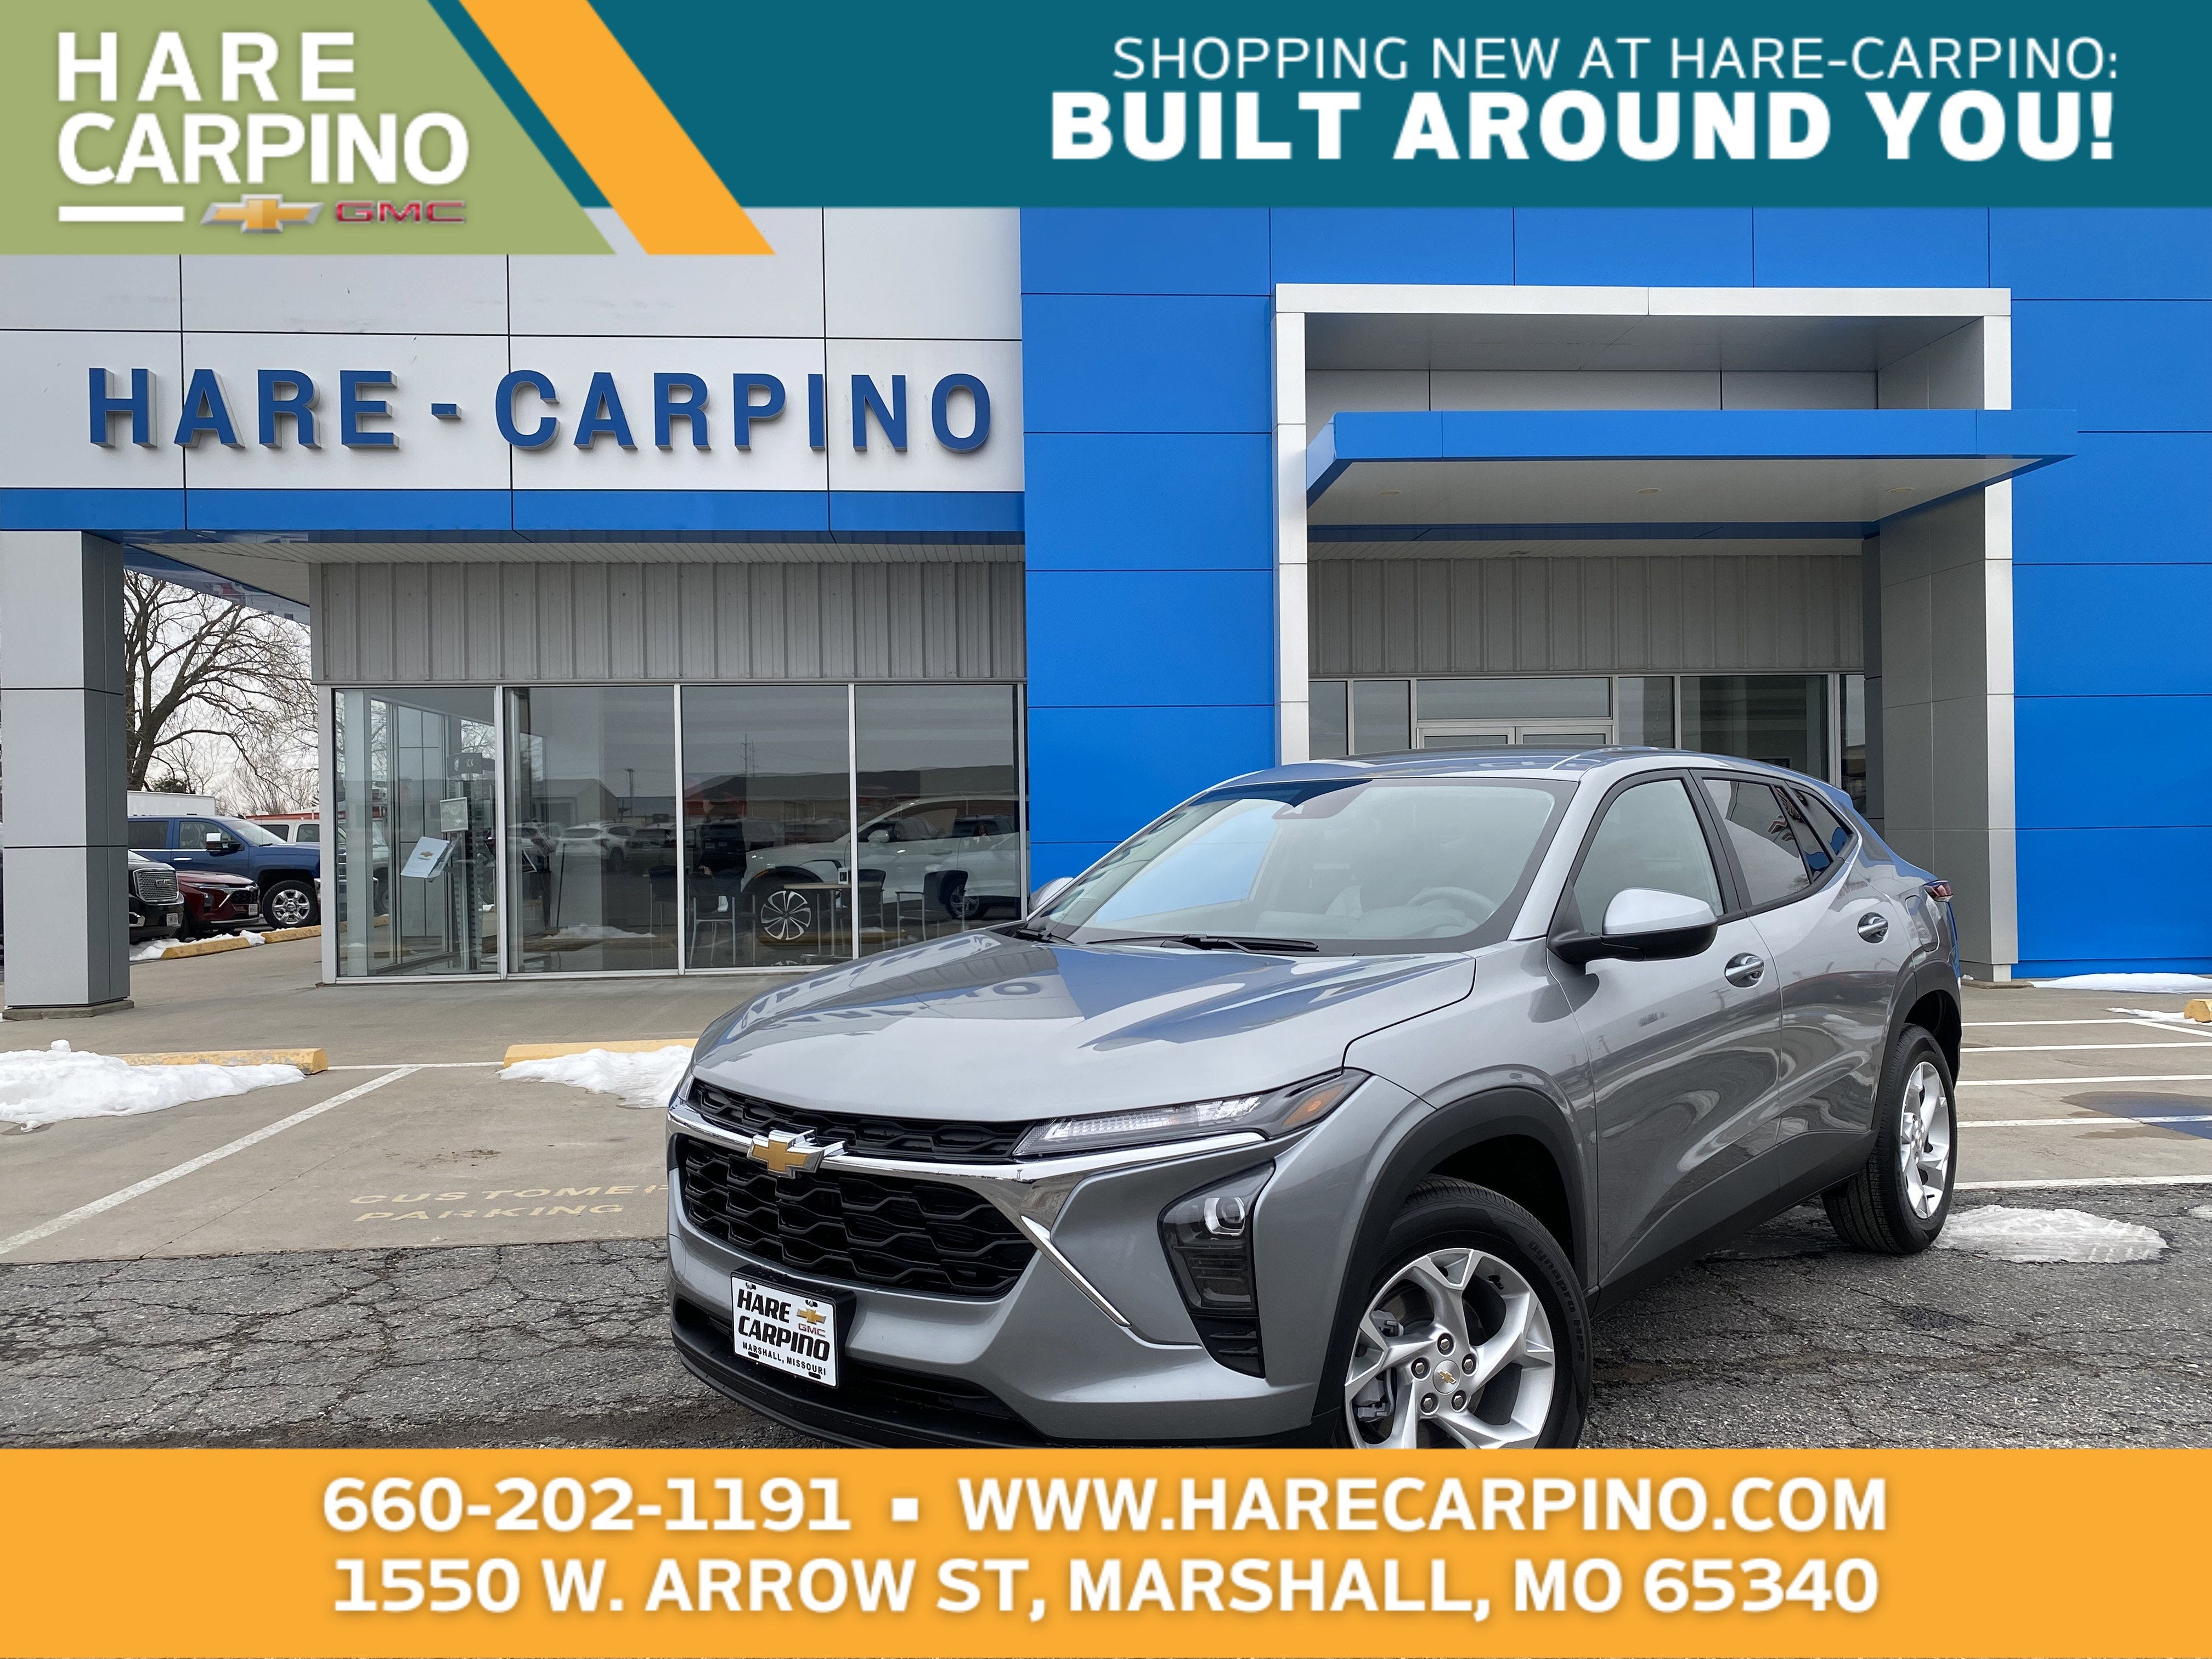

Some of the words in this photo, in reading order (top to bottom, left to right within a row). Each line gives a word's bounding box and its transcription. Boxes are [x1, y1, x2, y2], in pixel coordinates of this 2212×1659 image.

[89, 368, 396, 447] HARE
[495, 369, 992, 453] CARPINO
[353, 1204, 625, 1222] PARKING
[737, 1288, 792, 1324] HARE
[738, 1315, 831, 1362] CARPINO
[798, 1323, 826, 1338] GMC
[742, 1341, 785, 1364] MARSHALL,
[786, 1356, 827, 1376] MISSOURI
